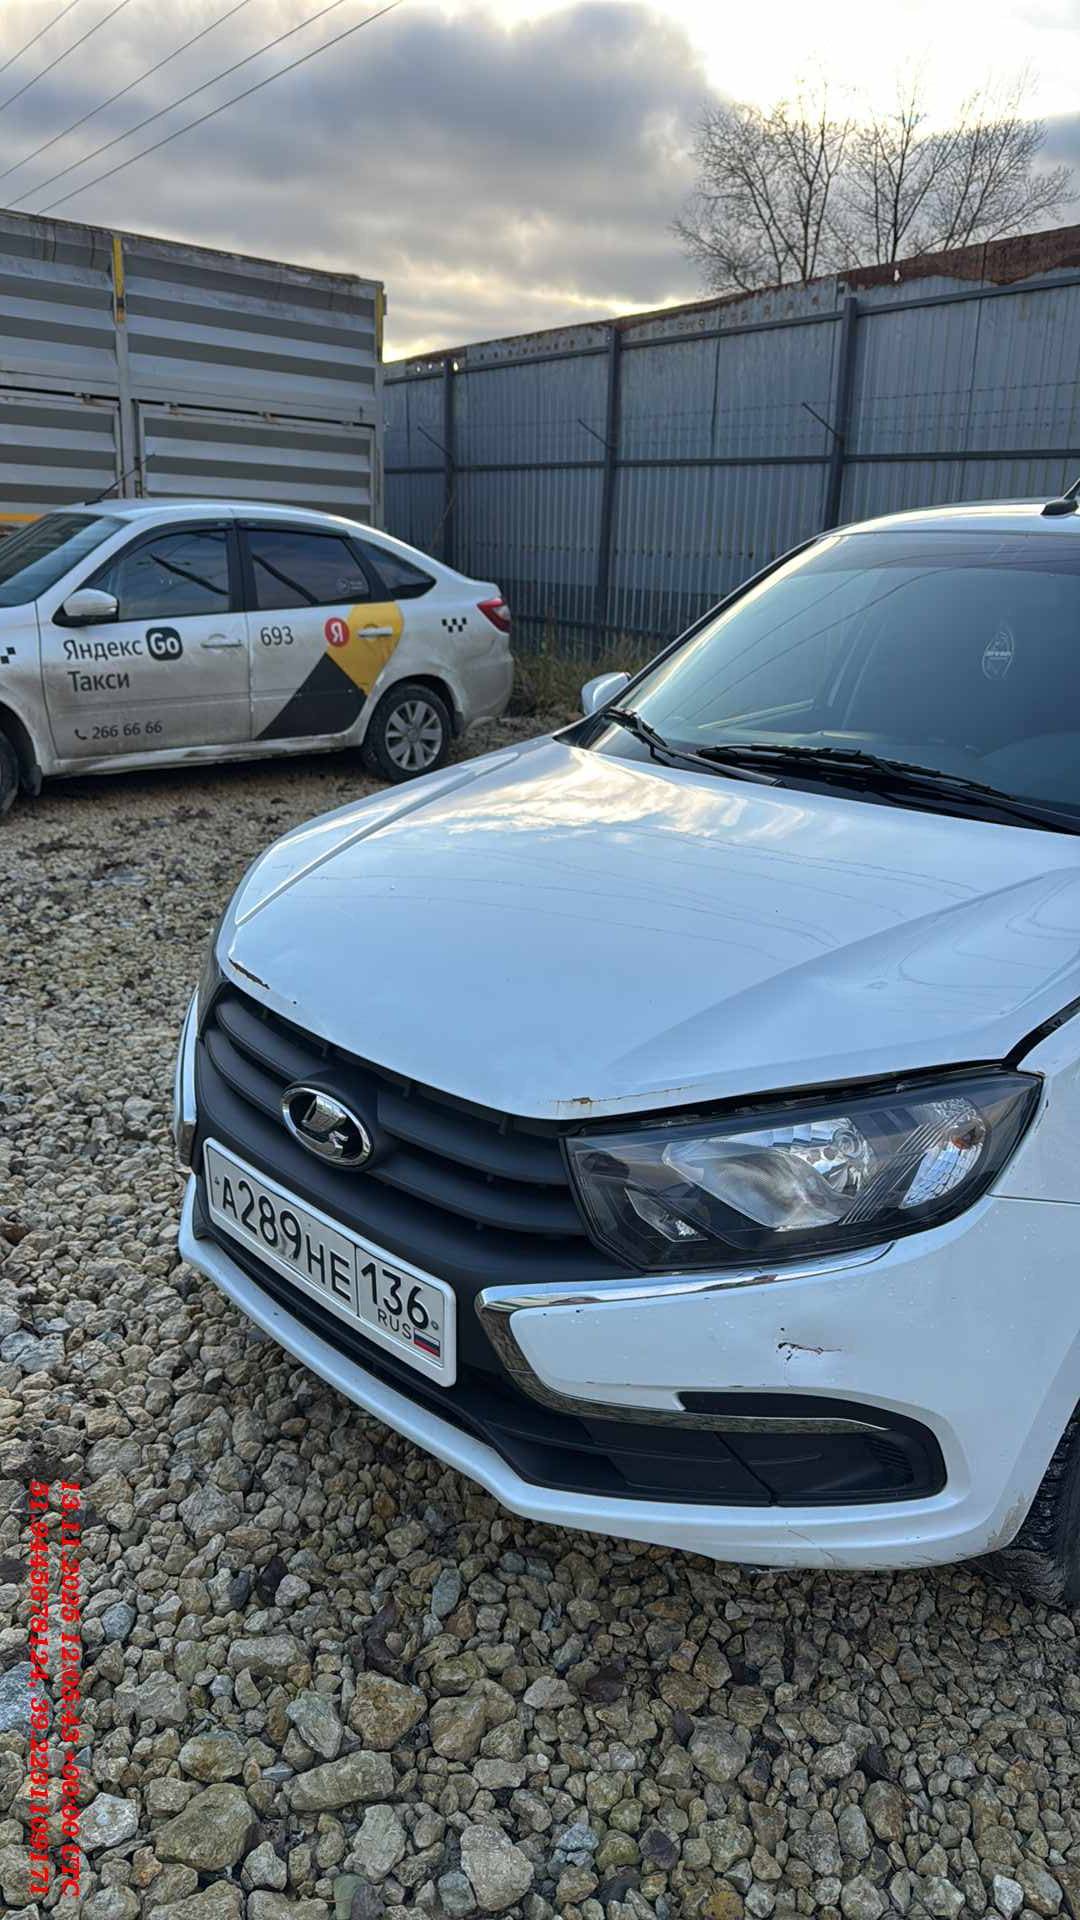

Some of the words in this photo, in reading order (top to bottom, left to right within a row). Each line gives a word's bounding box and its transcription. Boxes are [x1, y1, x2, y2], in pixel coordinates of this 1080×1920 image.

[260, 626, 294, 647] 693
[330, 621, 344, 643] Я
[63, 639, 143, 661] Яндекс
[149, 632, 180, 656] Go
[67, 671, 130, 692] Такси
[92, 725, 118, 740] 266
[123, 722, 141, 737] 66
[145, 720, 163, 734] 66
[361, 1262, 429, 1330] 136
[377, 1308, 412, 1340] RUS
